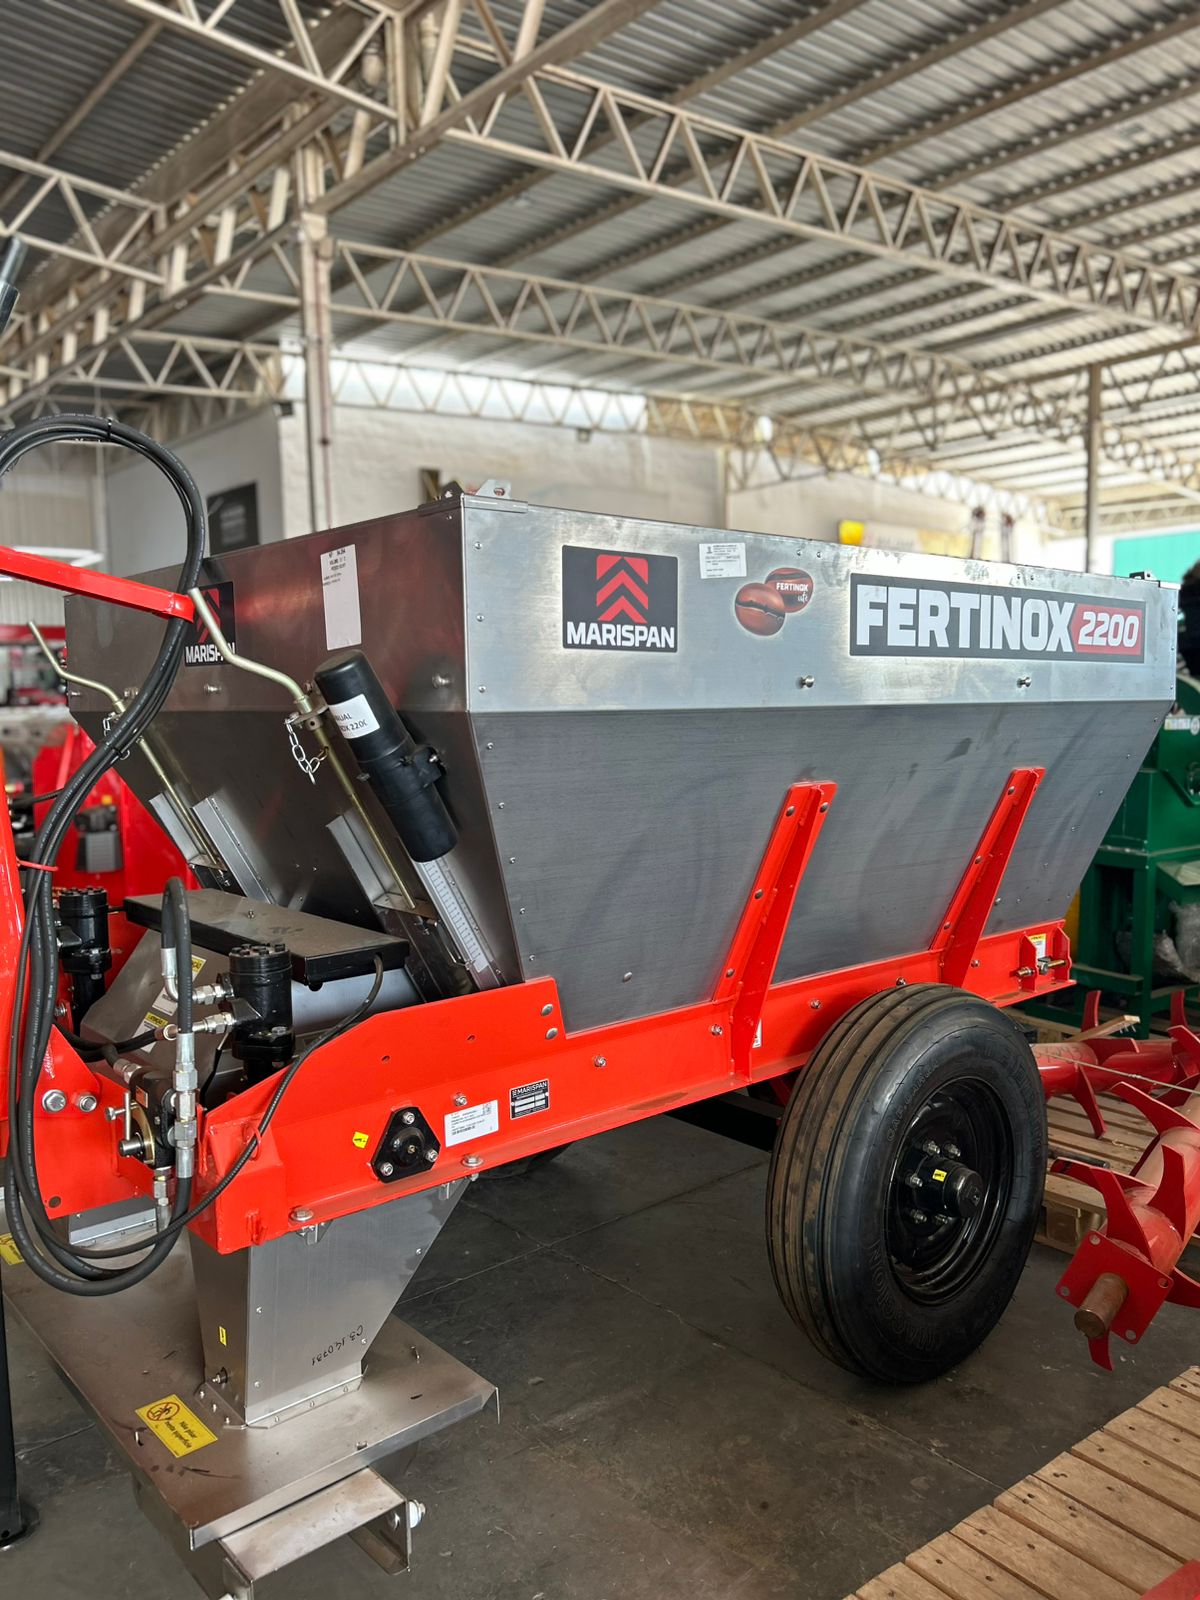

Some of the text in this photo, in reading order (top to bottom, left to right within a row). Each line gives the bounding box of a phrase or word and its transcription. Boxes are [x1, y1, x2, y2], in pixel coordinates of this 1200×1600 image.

[776, 582, 808, 591] FERTINOX
[856, 584, 1140, 653] FERTINOX 2200
[566, 621, 675, 649] MARISPAN
[185, 641, 236, 664] MARISPN
[516, 1081, 547, 1095] MARISPAN
